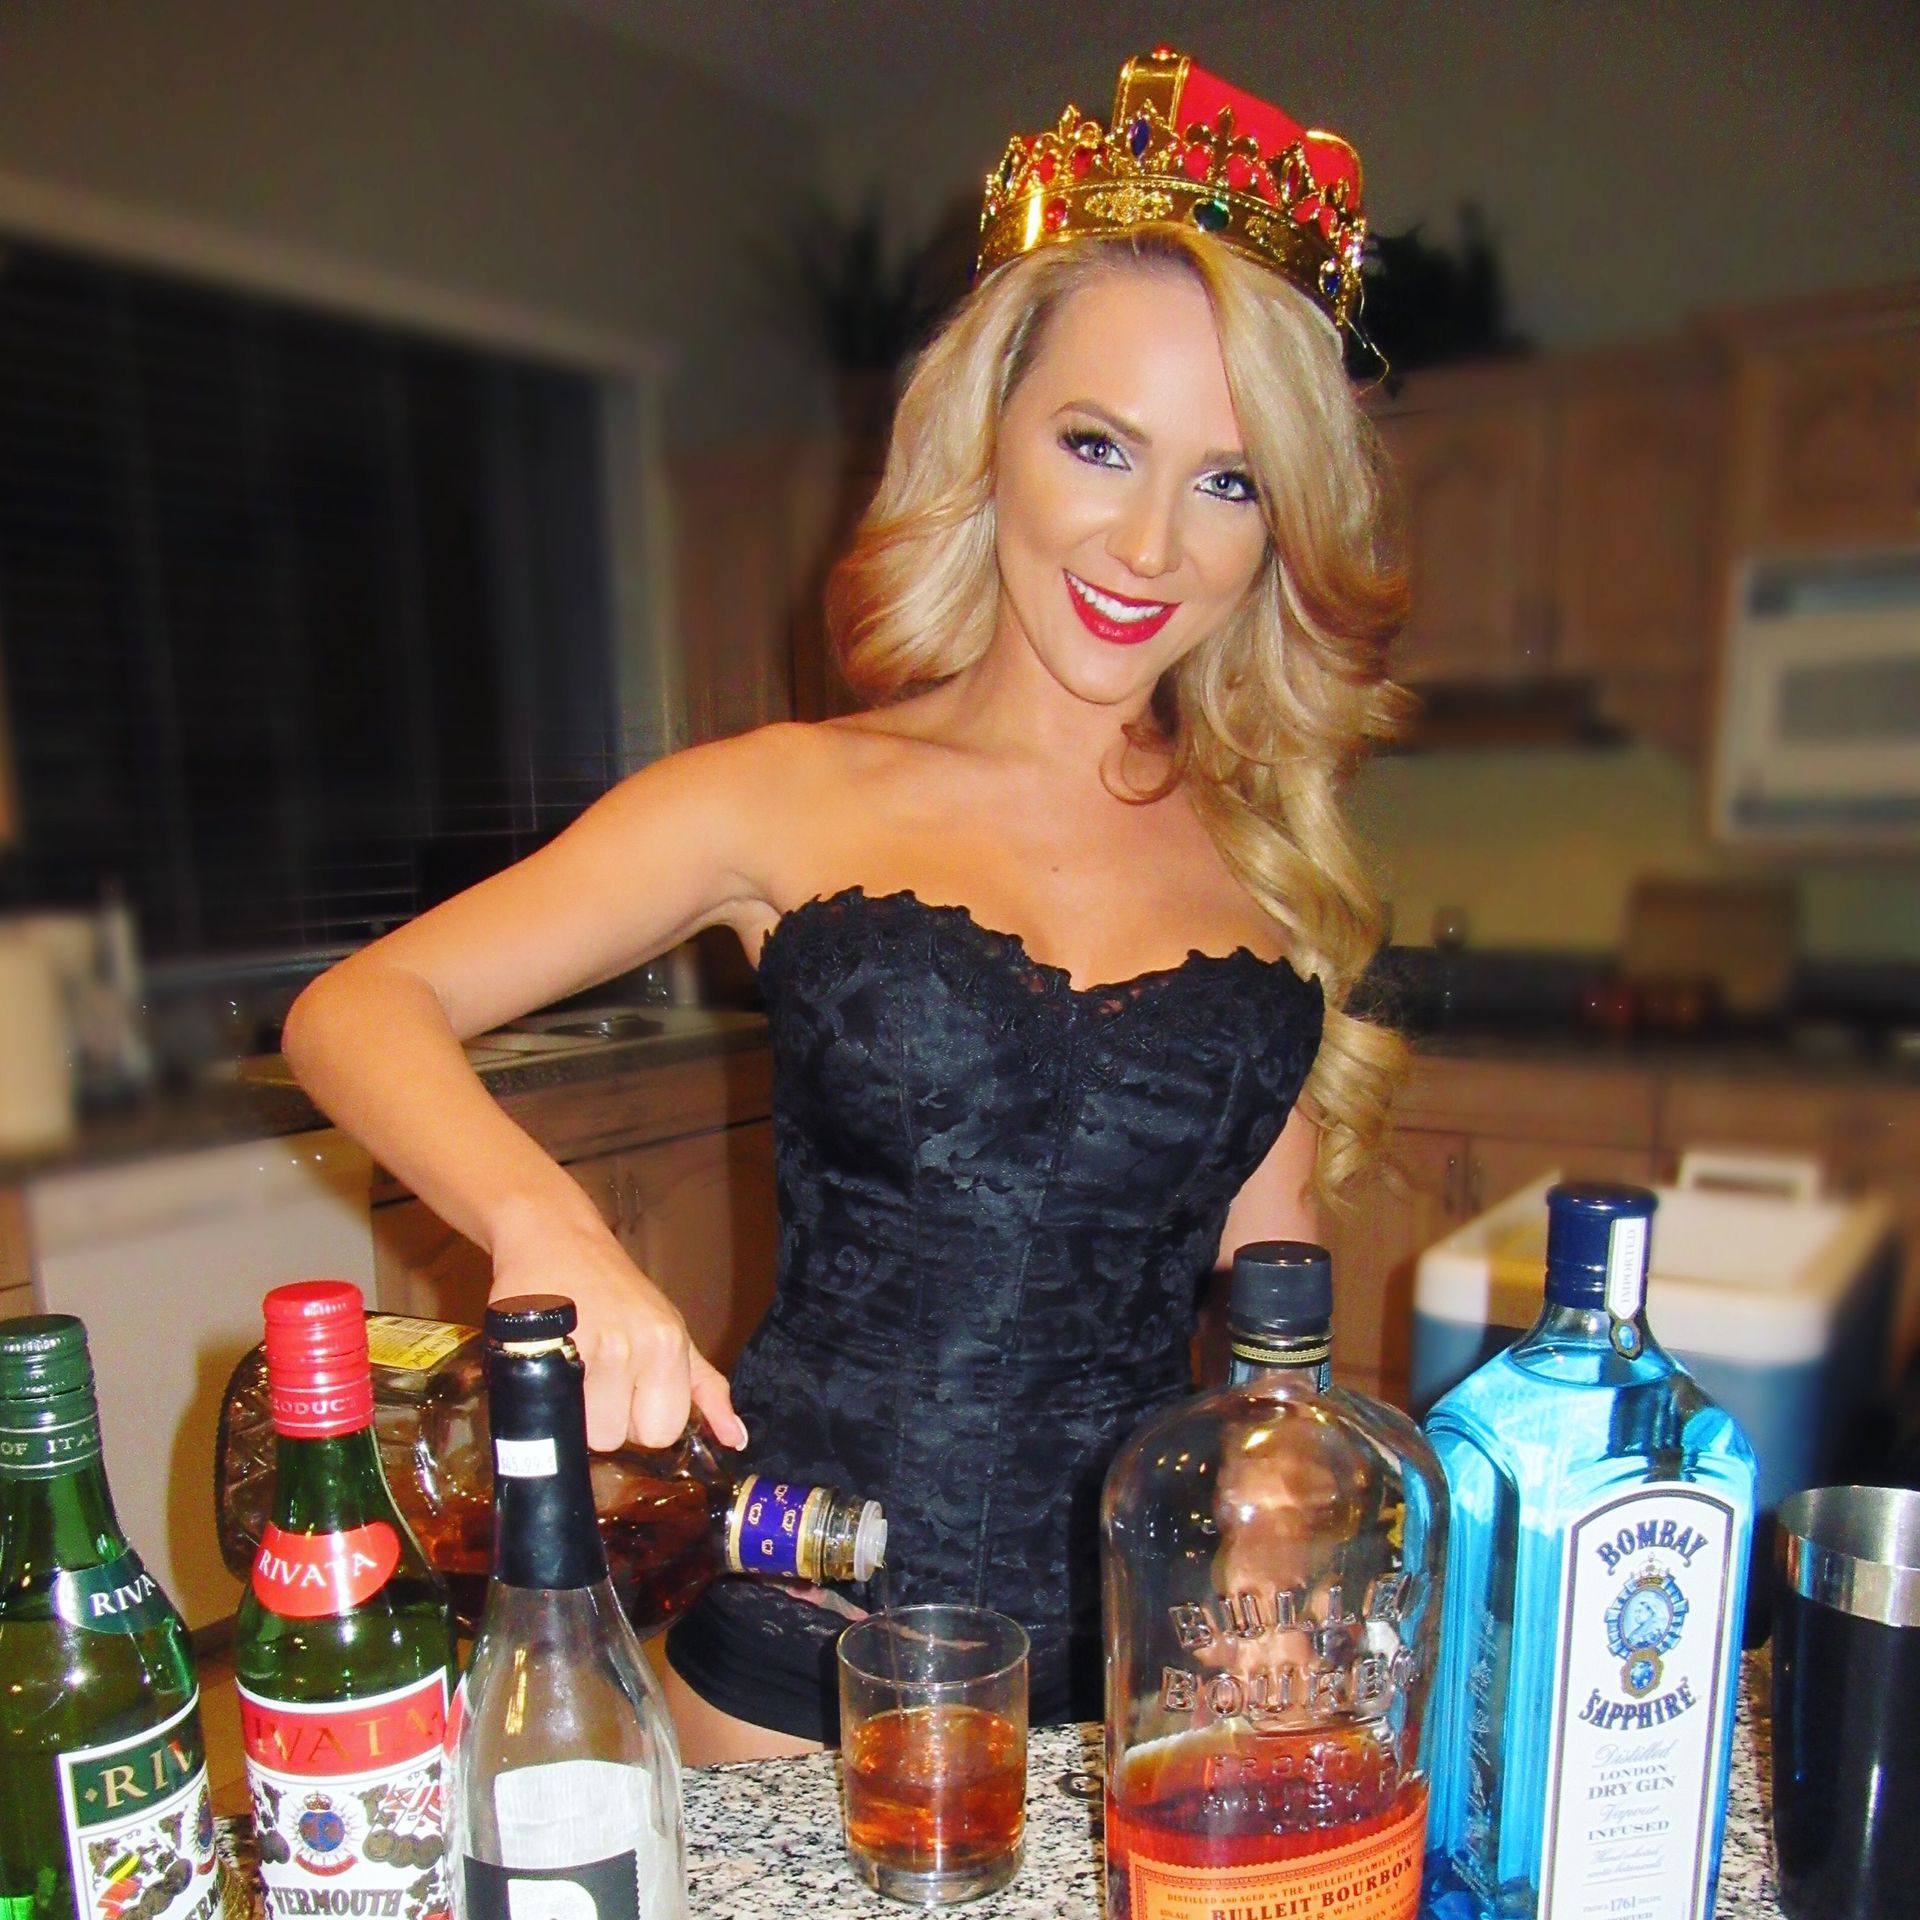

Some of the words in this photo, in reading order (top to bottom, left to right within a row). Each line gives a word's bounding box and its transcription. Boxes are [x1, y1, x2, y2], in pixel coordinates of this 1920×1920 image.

[1621, 1229, 1636, 1303] IMPORTED
[0, 1441, 28, 1456] OF
[1596, 1518, 1709, 1576] BOMBAY
[258, 1548, 378, 1589] RIVATA
[1578, 1676, 1697, 1731] SAPPHIRE
[1592, 1738, 1679, 1768] Distilled
[1587, 1781, 1632, 1800] DRY
[1635, 1775, 1677, 1793] GIN
[1600, 1764, 1668, 1782] LONDON
[1586, 1820, 1670, 1841] INFUSED
[1167, 1893, 1217, 1905] DISTILLED
[1239, 1893, 1265, 1903] AGED
[1282, 1884, 1304, 1898] THE
[1309, 1871, 1354, 1892] BULLEIT
[1358, 1855, 1393, 1877] FAMILY
[1321, 1854, 1413, 1908] BOURBON
[271, 1886, 403, 1917] VERMOUTH
[1333, 1881, 1401, 1916] WHISKEY
[1611, 1895, 1636, 1912] 1761
